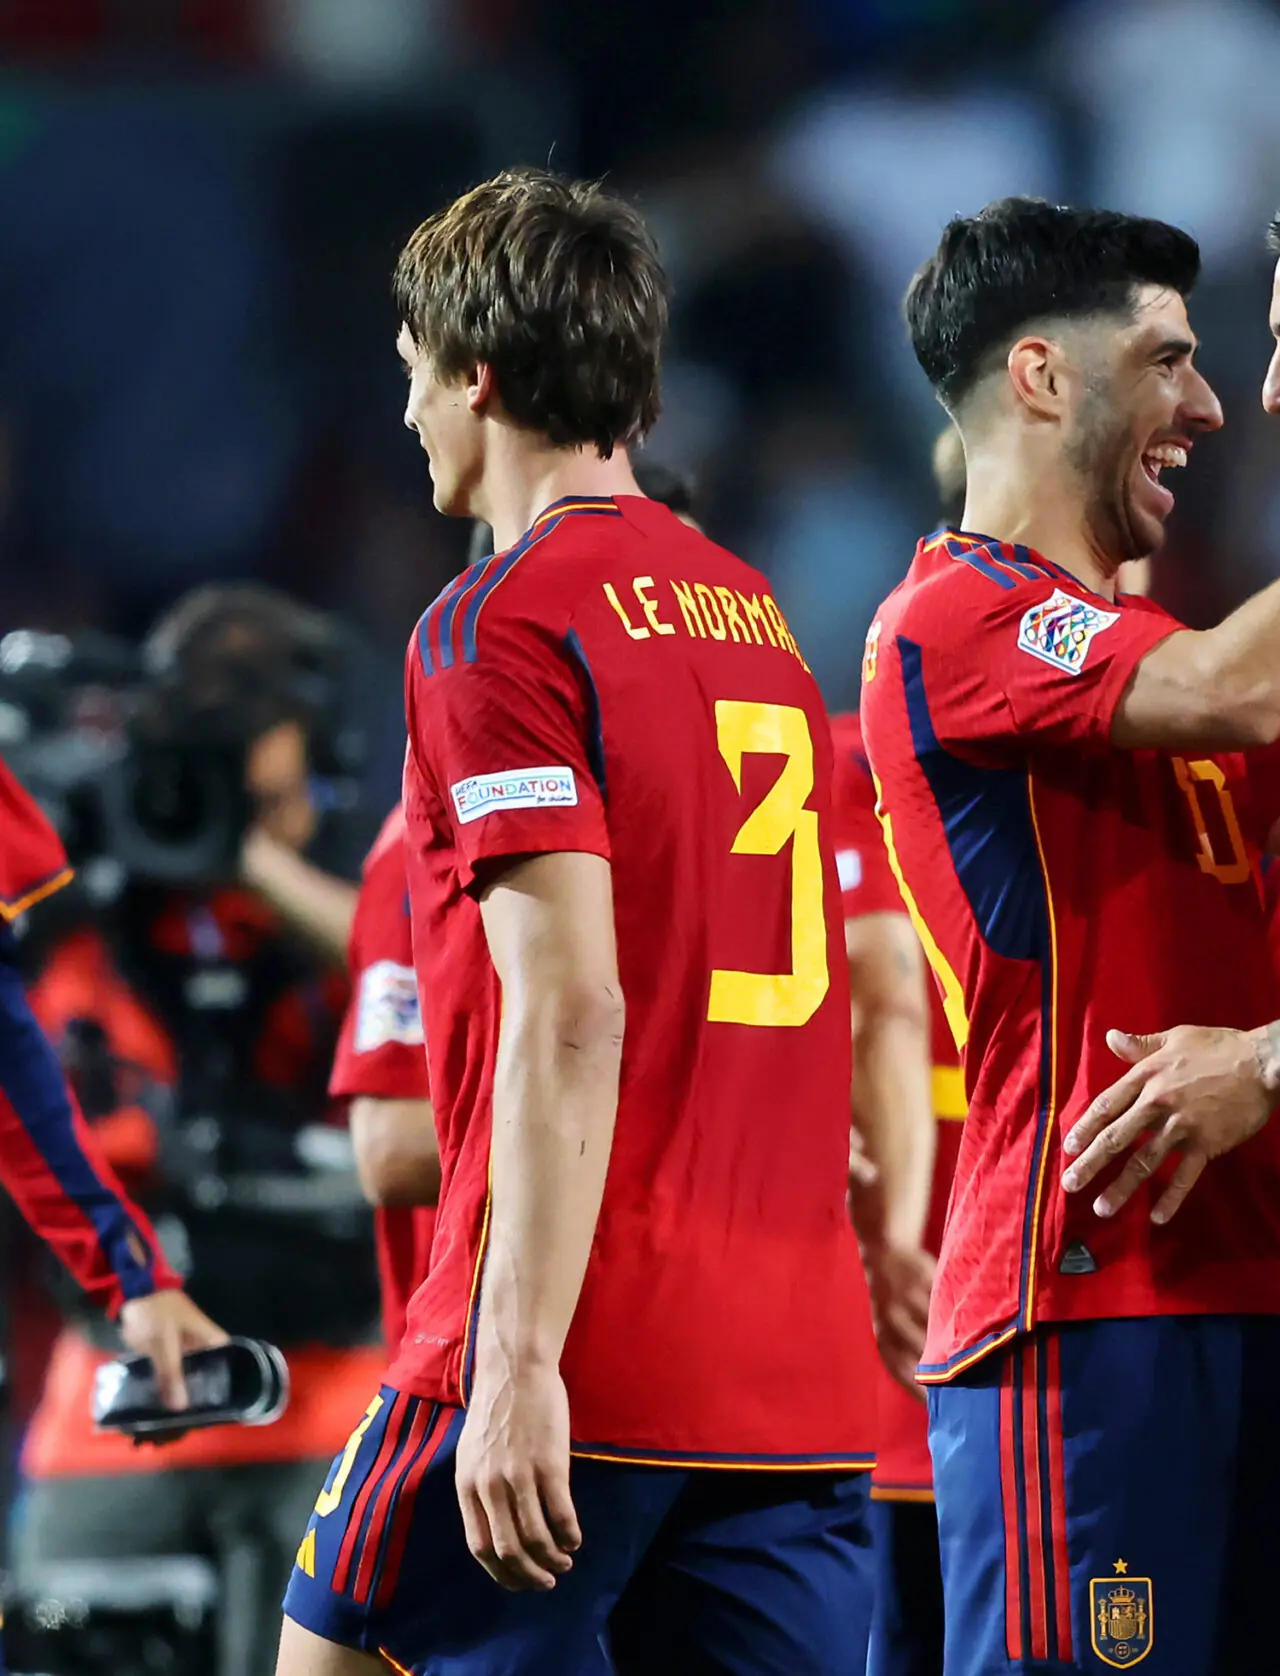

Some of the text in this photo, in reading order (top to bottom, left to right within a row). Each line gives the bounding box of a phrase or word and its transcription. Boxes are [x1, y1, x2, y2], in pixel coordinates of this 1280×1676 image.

[602, 576, 676, 640] LE
[669, 580, 812, 674] NORMA
[456, 779, 572, 810] FOUNDATION
[707, 700, 830, 1026] 3
